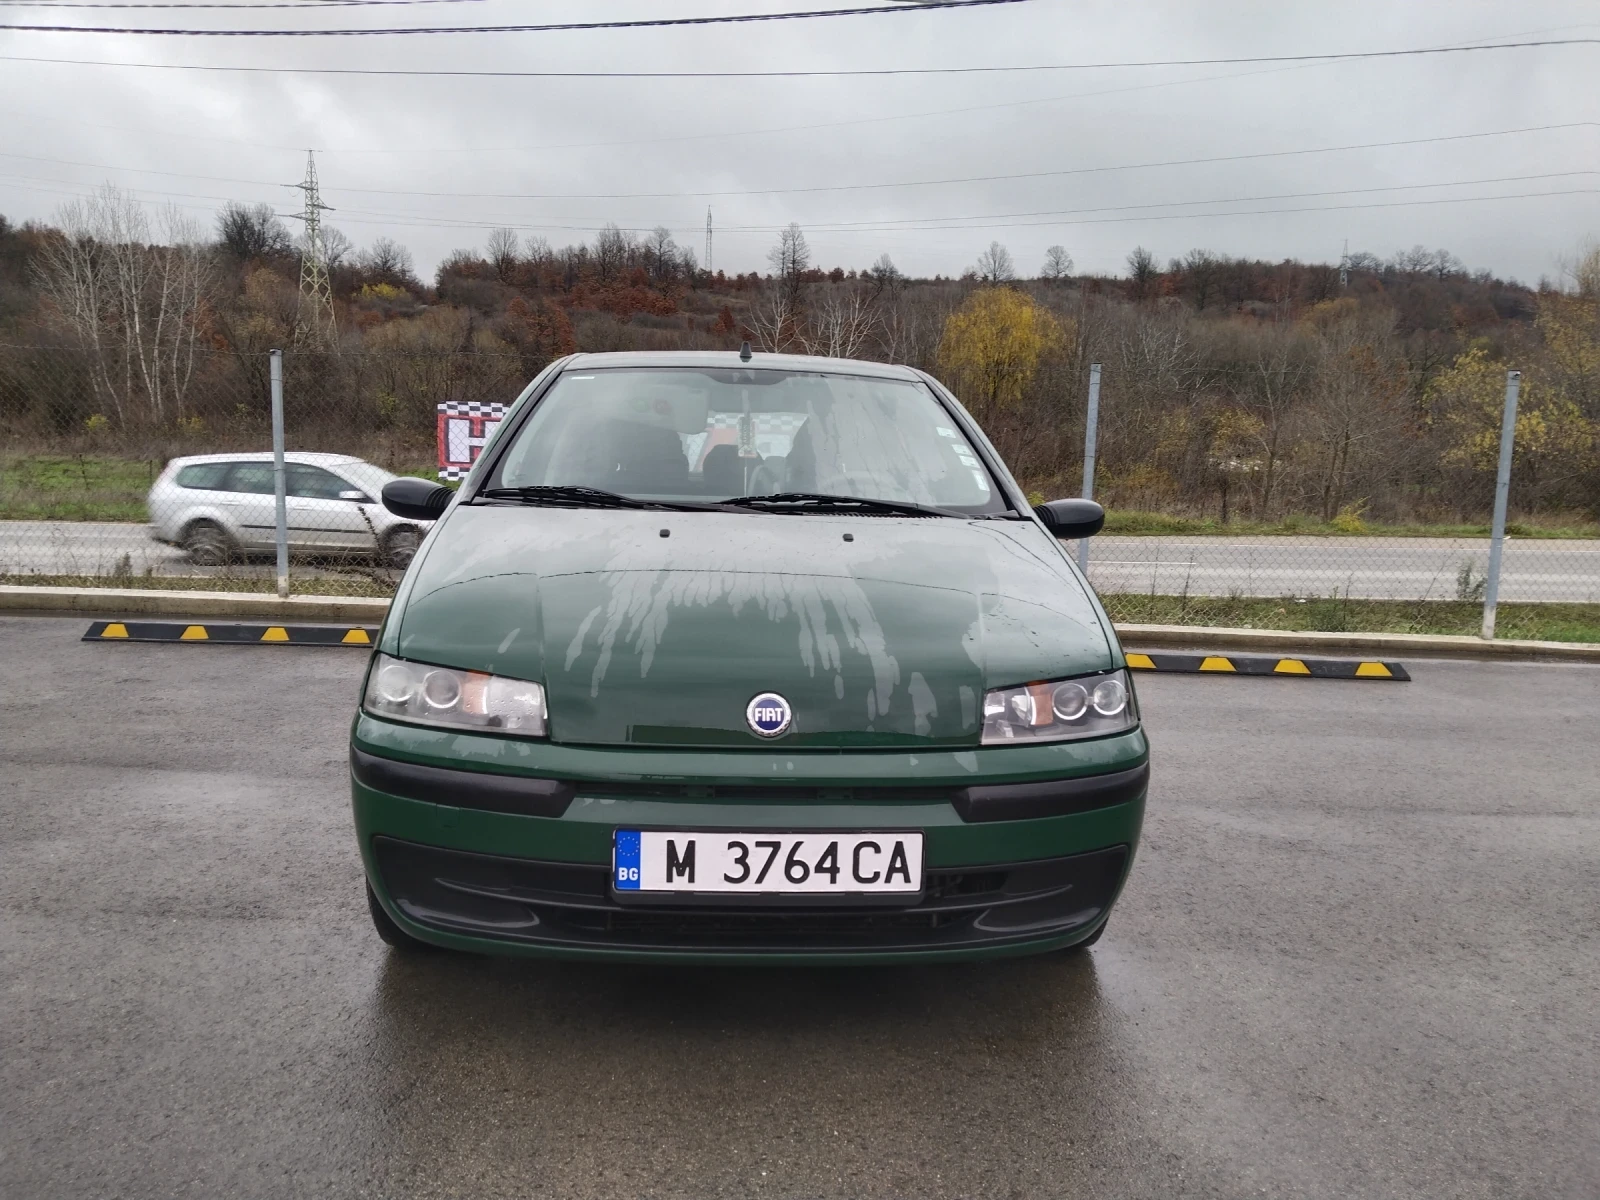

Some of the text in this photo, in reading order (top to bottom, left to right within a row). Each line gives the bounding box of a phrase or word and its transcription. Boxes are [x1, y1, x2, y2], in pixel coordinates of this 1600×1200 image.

[755, 708, 783, 721] FIAT
[666, 840, 695, 883] M
[618, 867, 638, 880] BG
